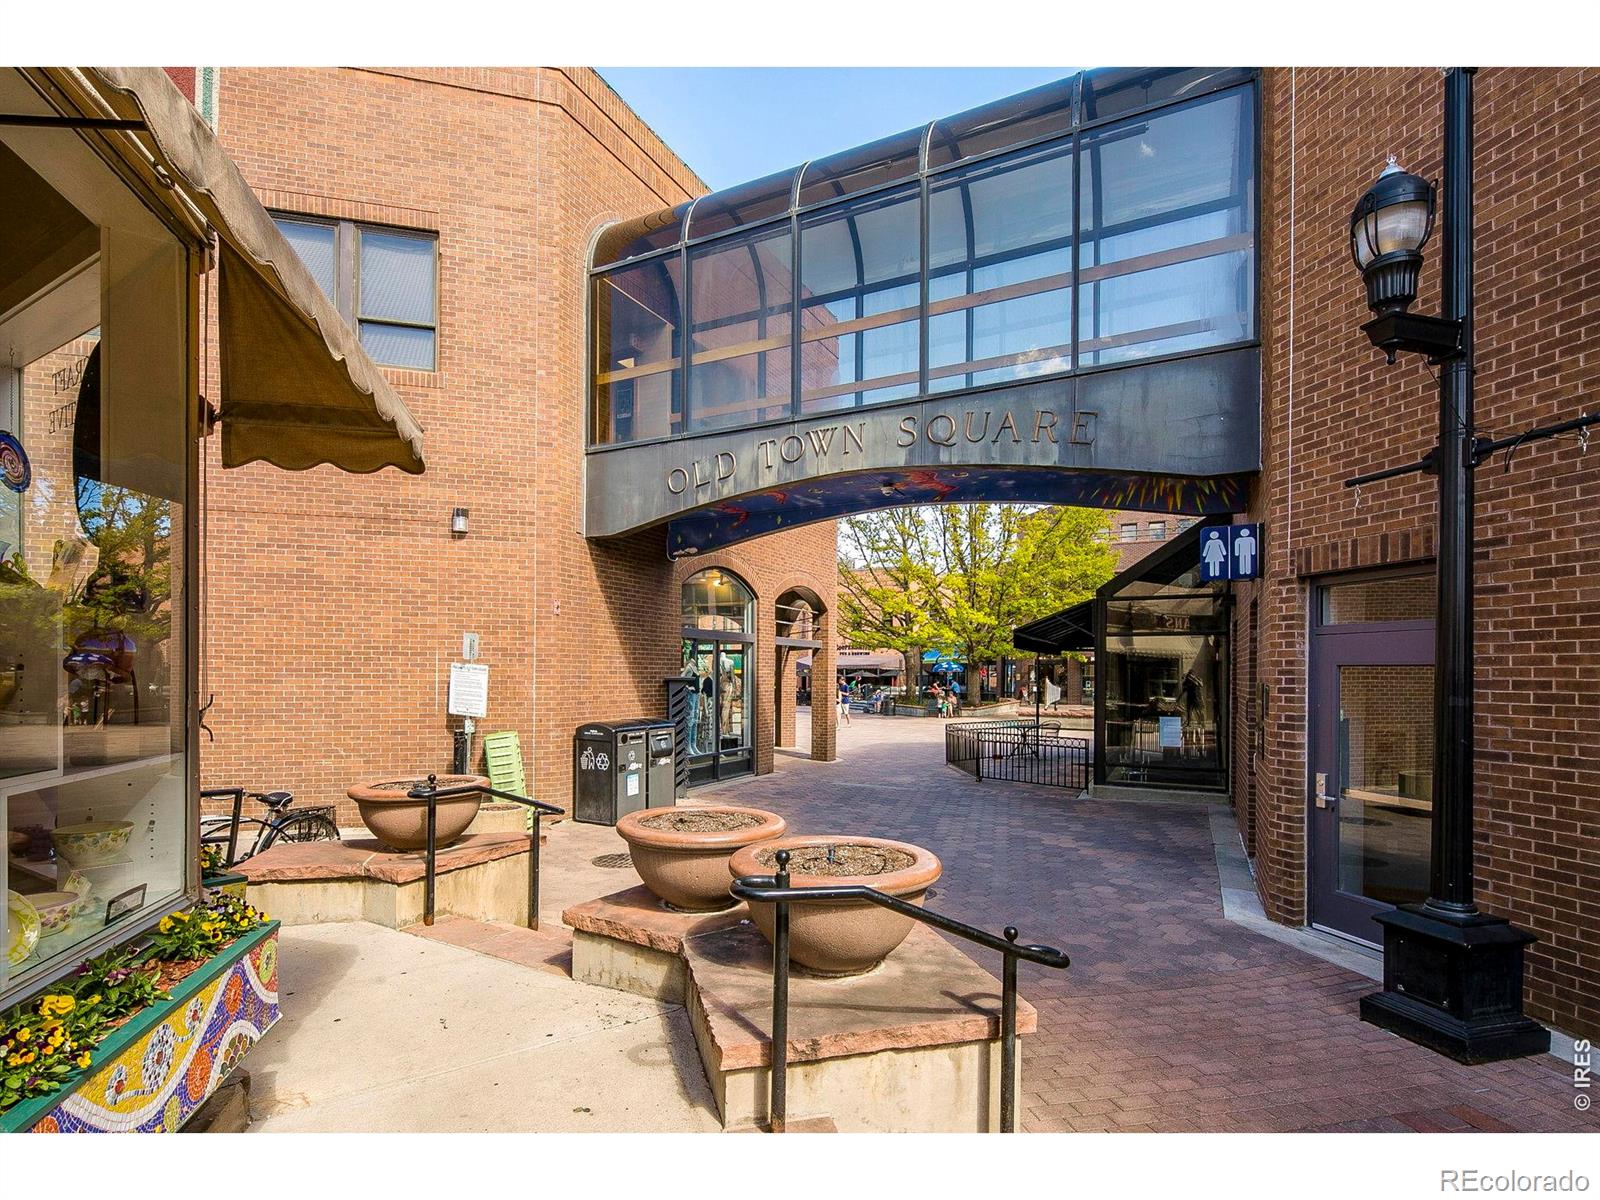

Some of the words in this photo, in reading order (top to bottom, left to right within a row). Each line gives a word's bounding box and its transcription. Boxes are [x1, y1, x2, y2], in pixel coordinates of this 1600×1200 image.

[667, 449, 737, 494] OLD
[758, 421, 866, 469] TOWN
[896, 409, 1099, 448] SQUARE
